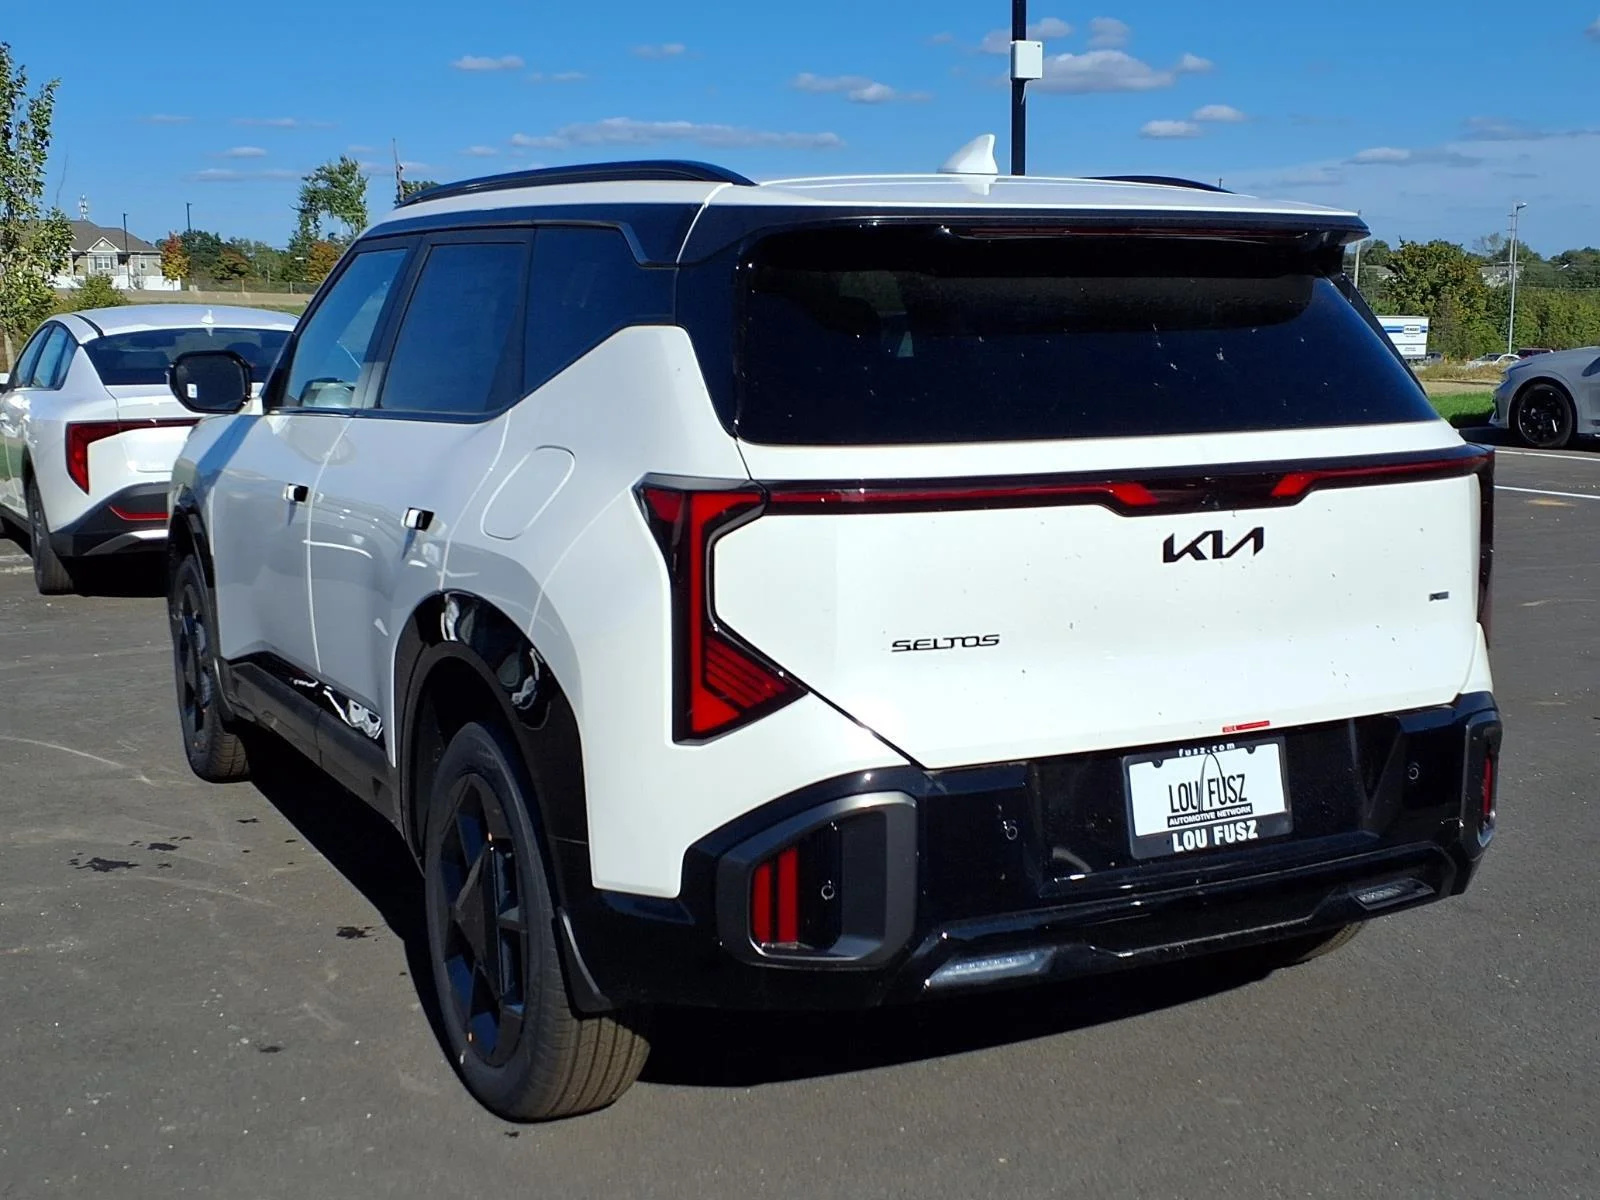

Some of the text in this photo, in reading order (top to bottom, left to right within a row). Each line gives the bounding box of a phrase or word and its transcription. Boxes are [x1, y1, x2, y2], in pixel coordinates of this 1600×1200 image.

[1163, 527, 1264, 563] KIA
[891, 634, 1000, 652] SELTOS
[1178, 743, 1236, 757] fusz.com
[1168, 773, 1248, 813] LOU FUSZ
[1169, 805, 1252, 826] AUTOMOTIVE NETWORK
[1172, 819, 1259, 852] LOU FUSZ
